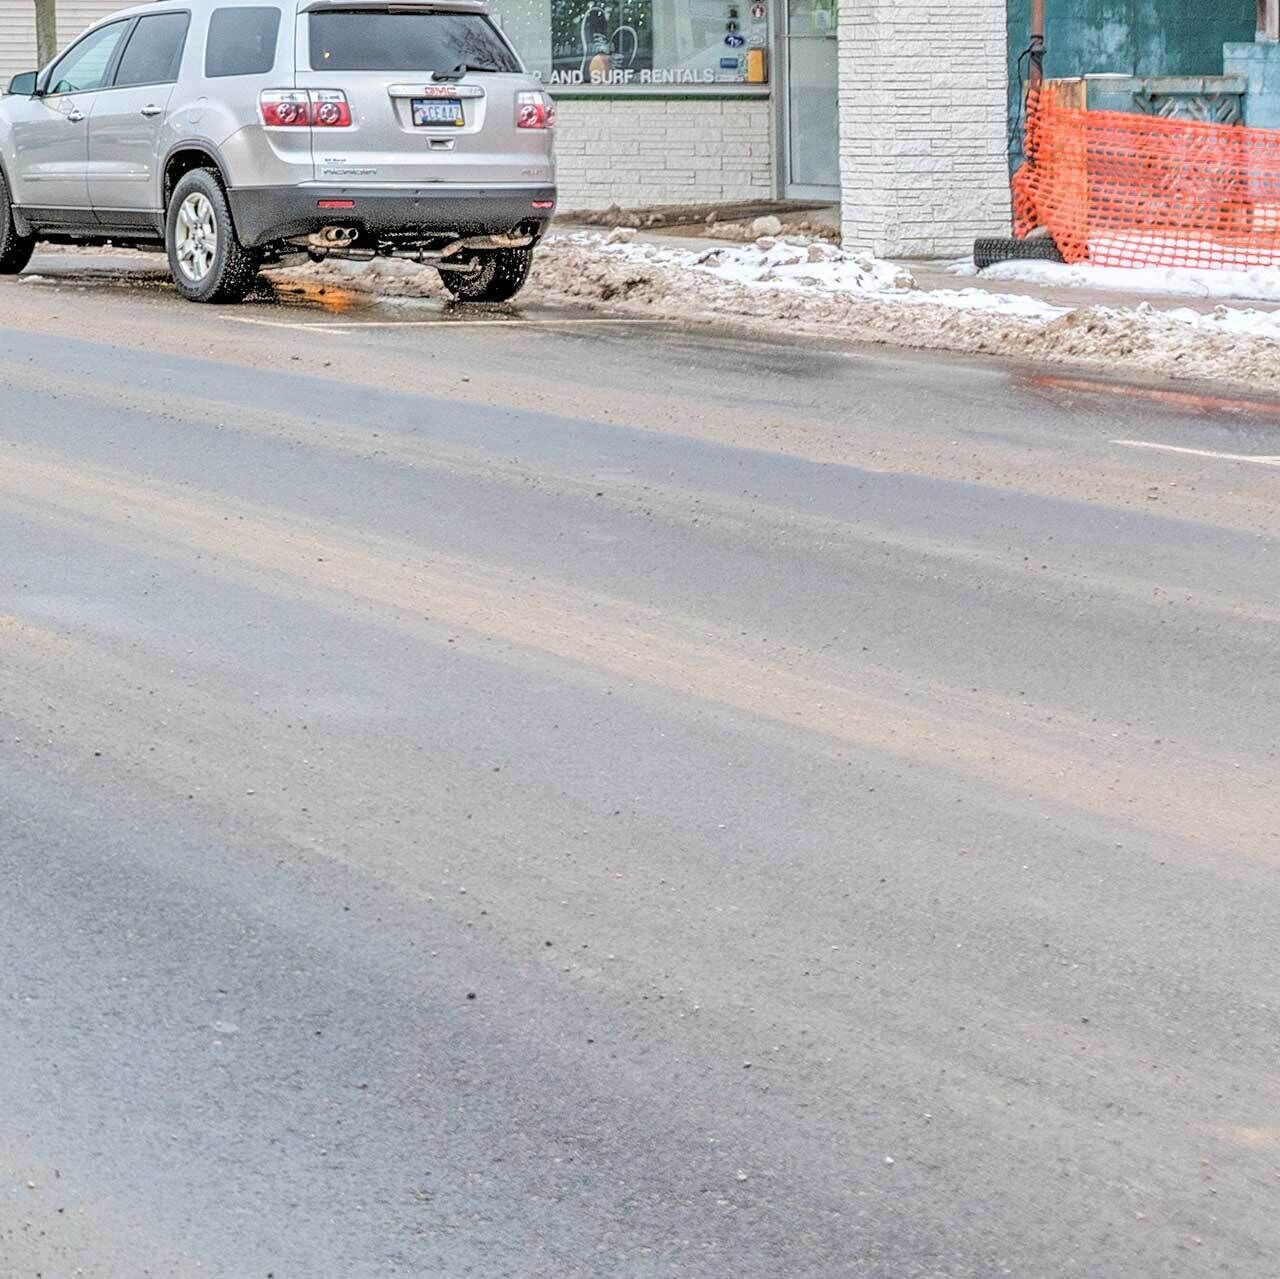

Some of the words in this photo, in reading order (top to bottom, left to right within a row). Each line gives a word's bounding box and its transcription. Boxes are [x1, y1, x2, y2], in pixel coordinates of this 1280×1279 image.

[550, 69, 584, 84] AND
[590, 69, 634, 84] SURF
[640, 69, 715, 84] RENTALS
